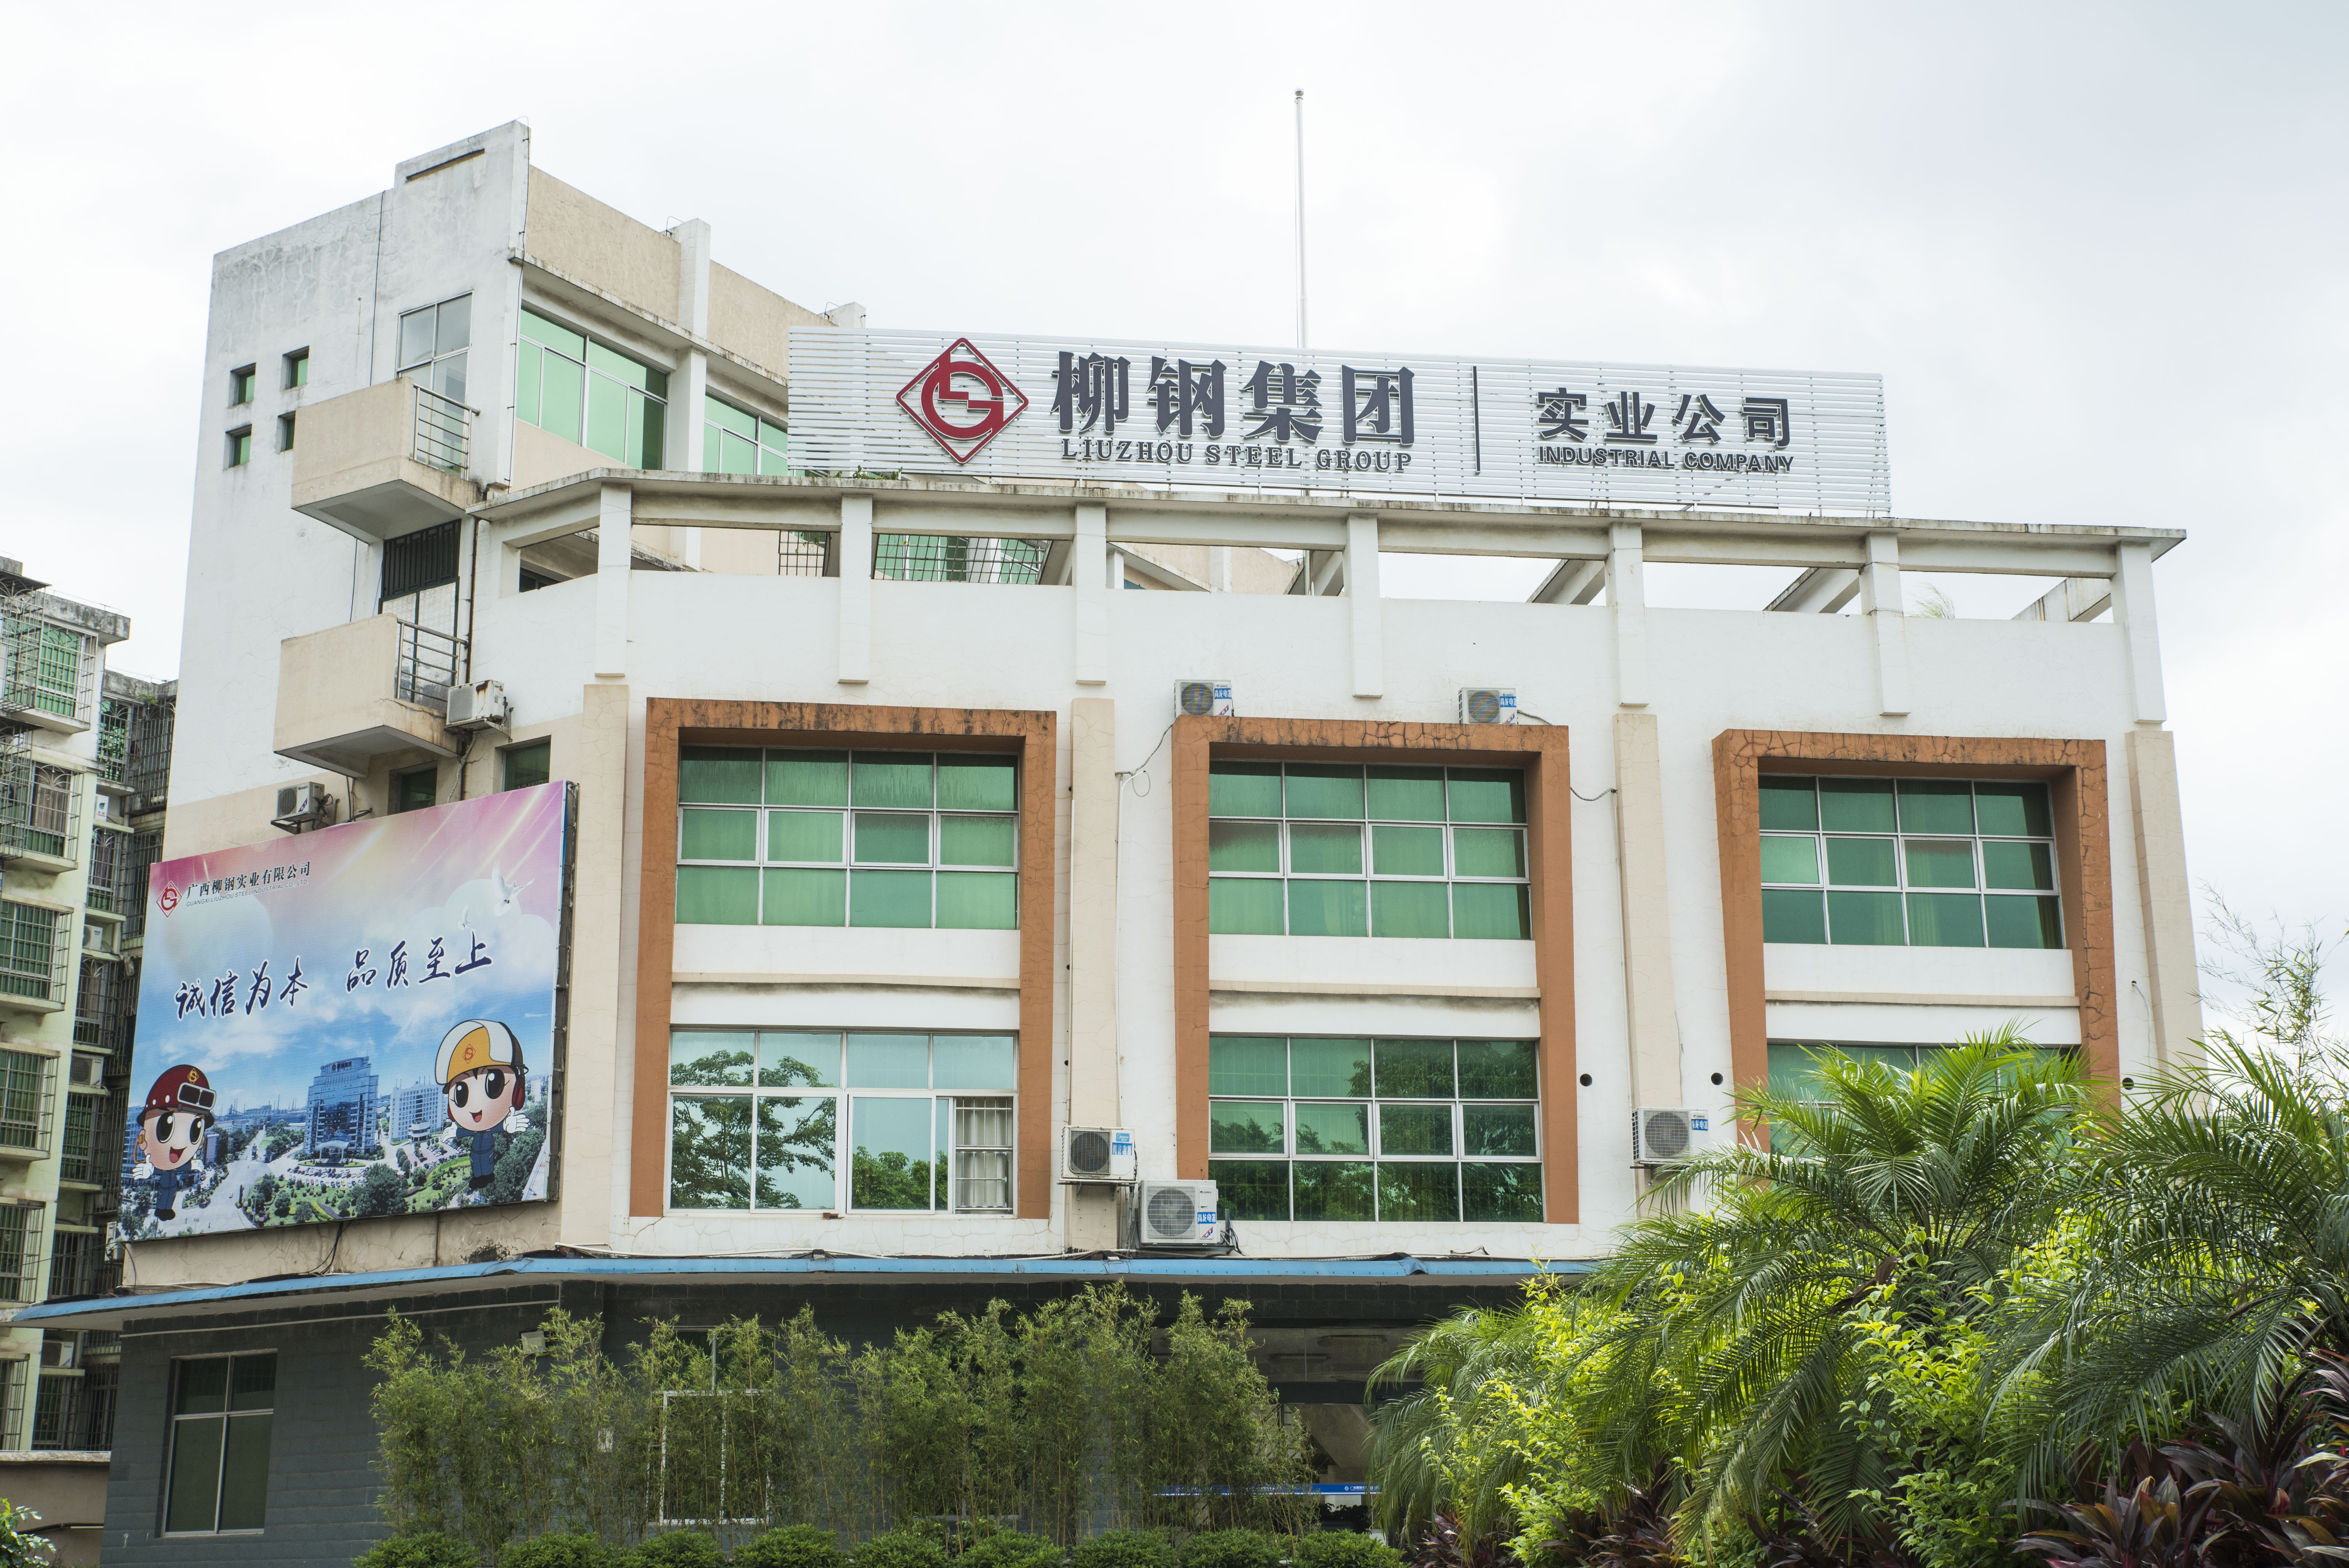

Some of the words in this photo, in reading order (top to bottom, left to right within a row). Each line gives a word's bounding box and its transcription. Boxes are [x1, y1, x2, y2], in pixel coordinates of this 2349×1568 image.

[1050, 350, 1415, 445] 柳钢集团
[1537, 387, 1791, 448] 实业公司
[1062, 438, 1194, 463] LIUZHOU
[1205, 444, 1303, 468] STEEL
[1316, 449, 1412, 472] GROUP
[1538, 446, 1675, 468] INDUSTRIAL
[1683, 452, 1794, 472] COMPANY
[186, 898, 210, 907] GUANGXI
[211, 893, 234, 902] LIUZHOU
[252, 884, 284, 894] INDUSTRIAL
[187, 861, 310, 899] 广西柳钢实业有限公司
[176, 957, 308, 1019] 诚信为本
[347, 930, 492, 992] 品质至上
[1198, 1213, 1216, 1222] 尚龙电器
